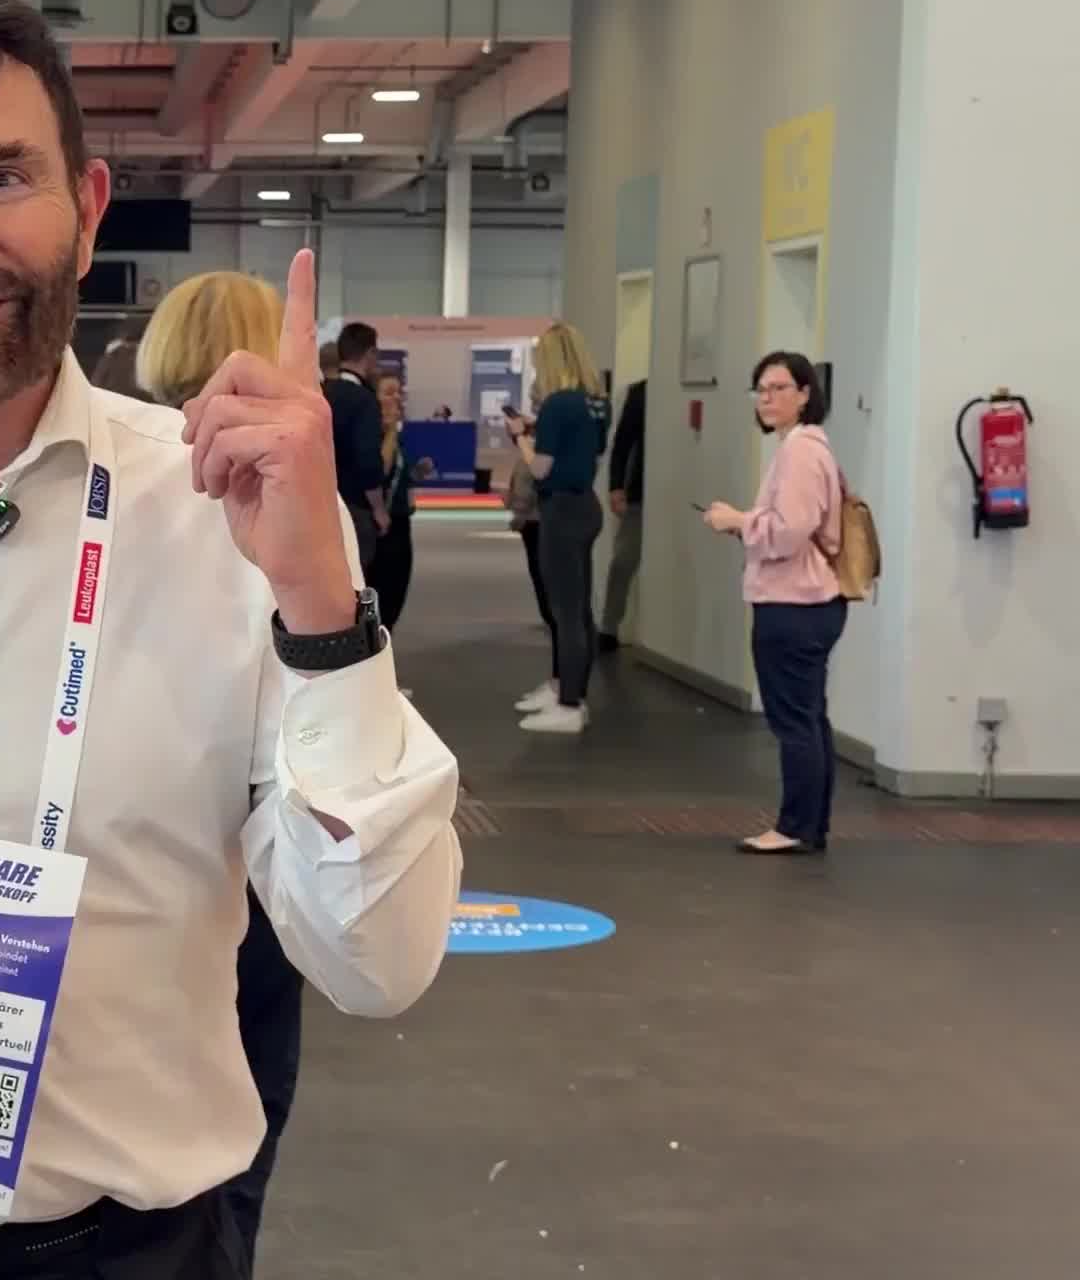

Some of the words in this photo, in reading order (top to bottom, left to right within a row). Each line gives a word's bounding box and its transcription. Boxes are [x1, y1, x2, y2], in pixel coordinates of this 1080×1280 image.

[77, 548, 99, 618] Leukoplast
[41, 801, 64, 849] ssity
[1, 934, 50, 953] Verstehen
